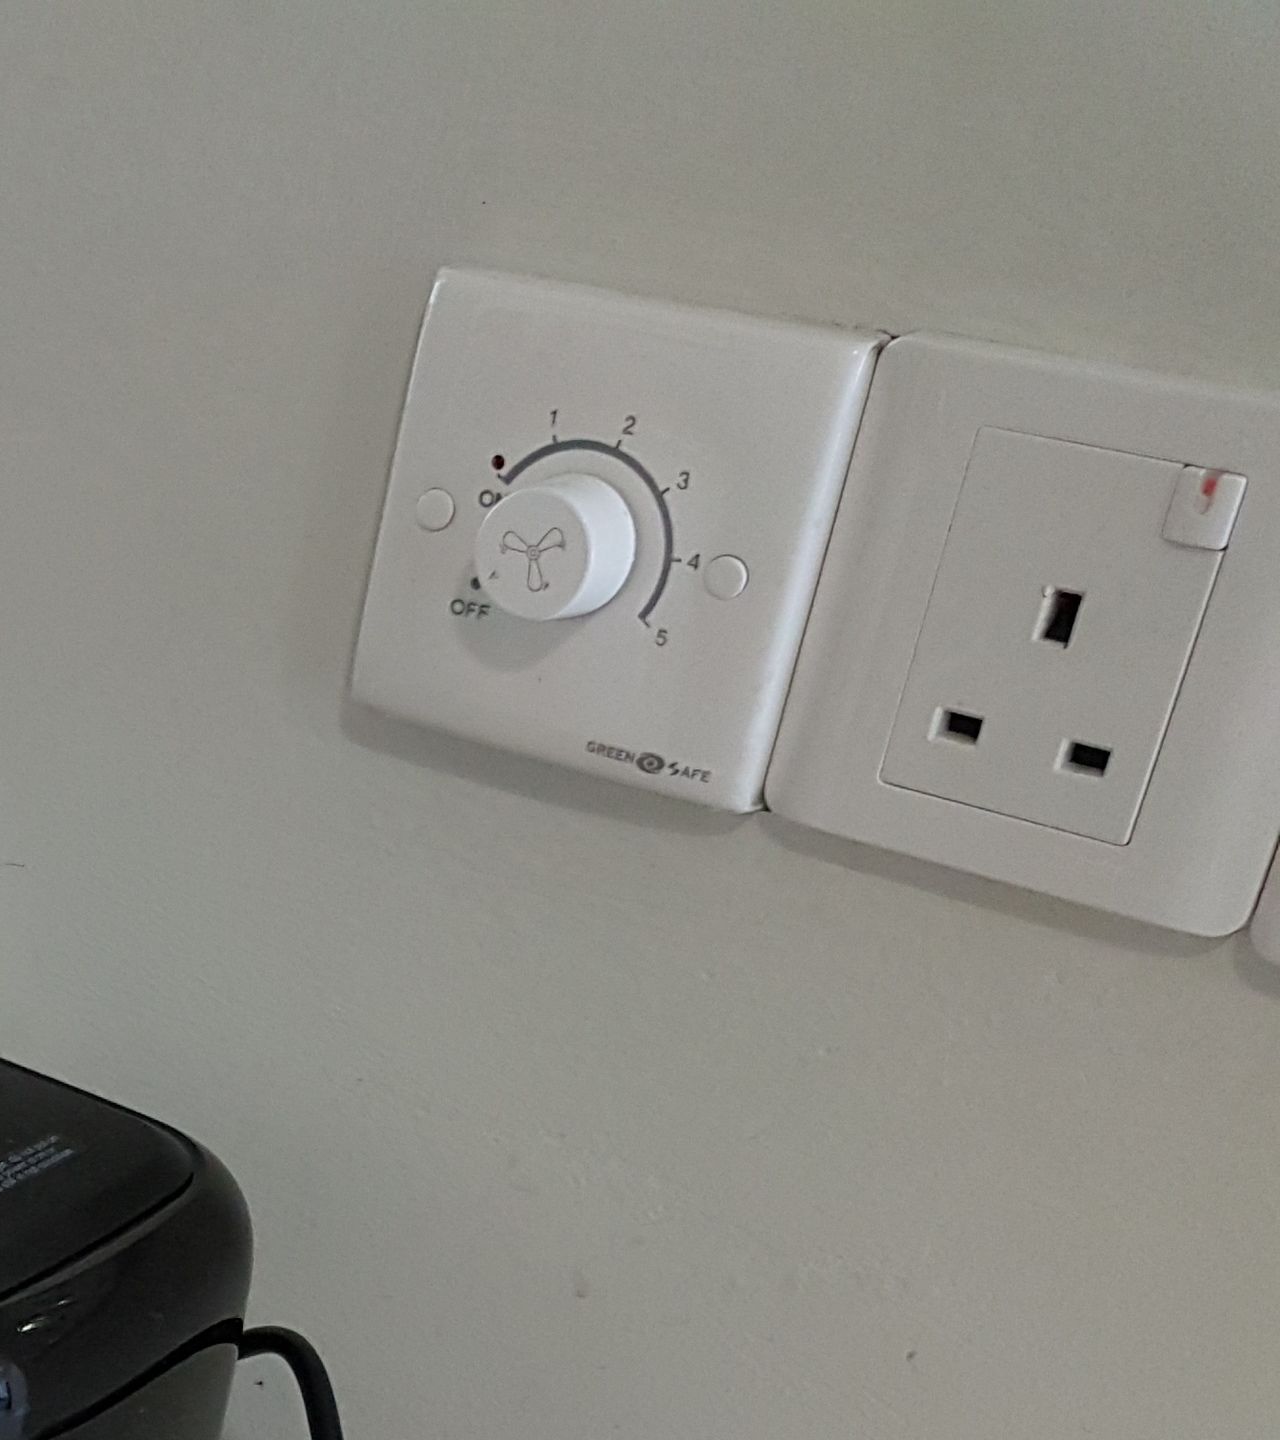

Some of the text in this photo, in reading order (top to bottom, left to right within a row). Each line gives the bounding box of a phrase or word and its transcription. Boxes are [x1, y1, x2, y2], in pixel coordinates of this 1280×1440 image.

[549, 409, 559, 425] 1
[622, 415, 637, 435] 2
[676, 471, 691, 490] 3
[686, 553, 701, 571] 4
[450, 598, 491, 620] OFF
[655, 629, 669, 647] 5
[586, 741, 712, 783] GREEN SAFE
